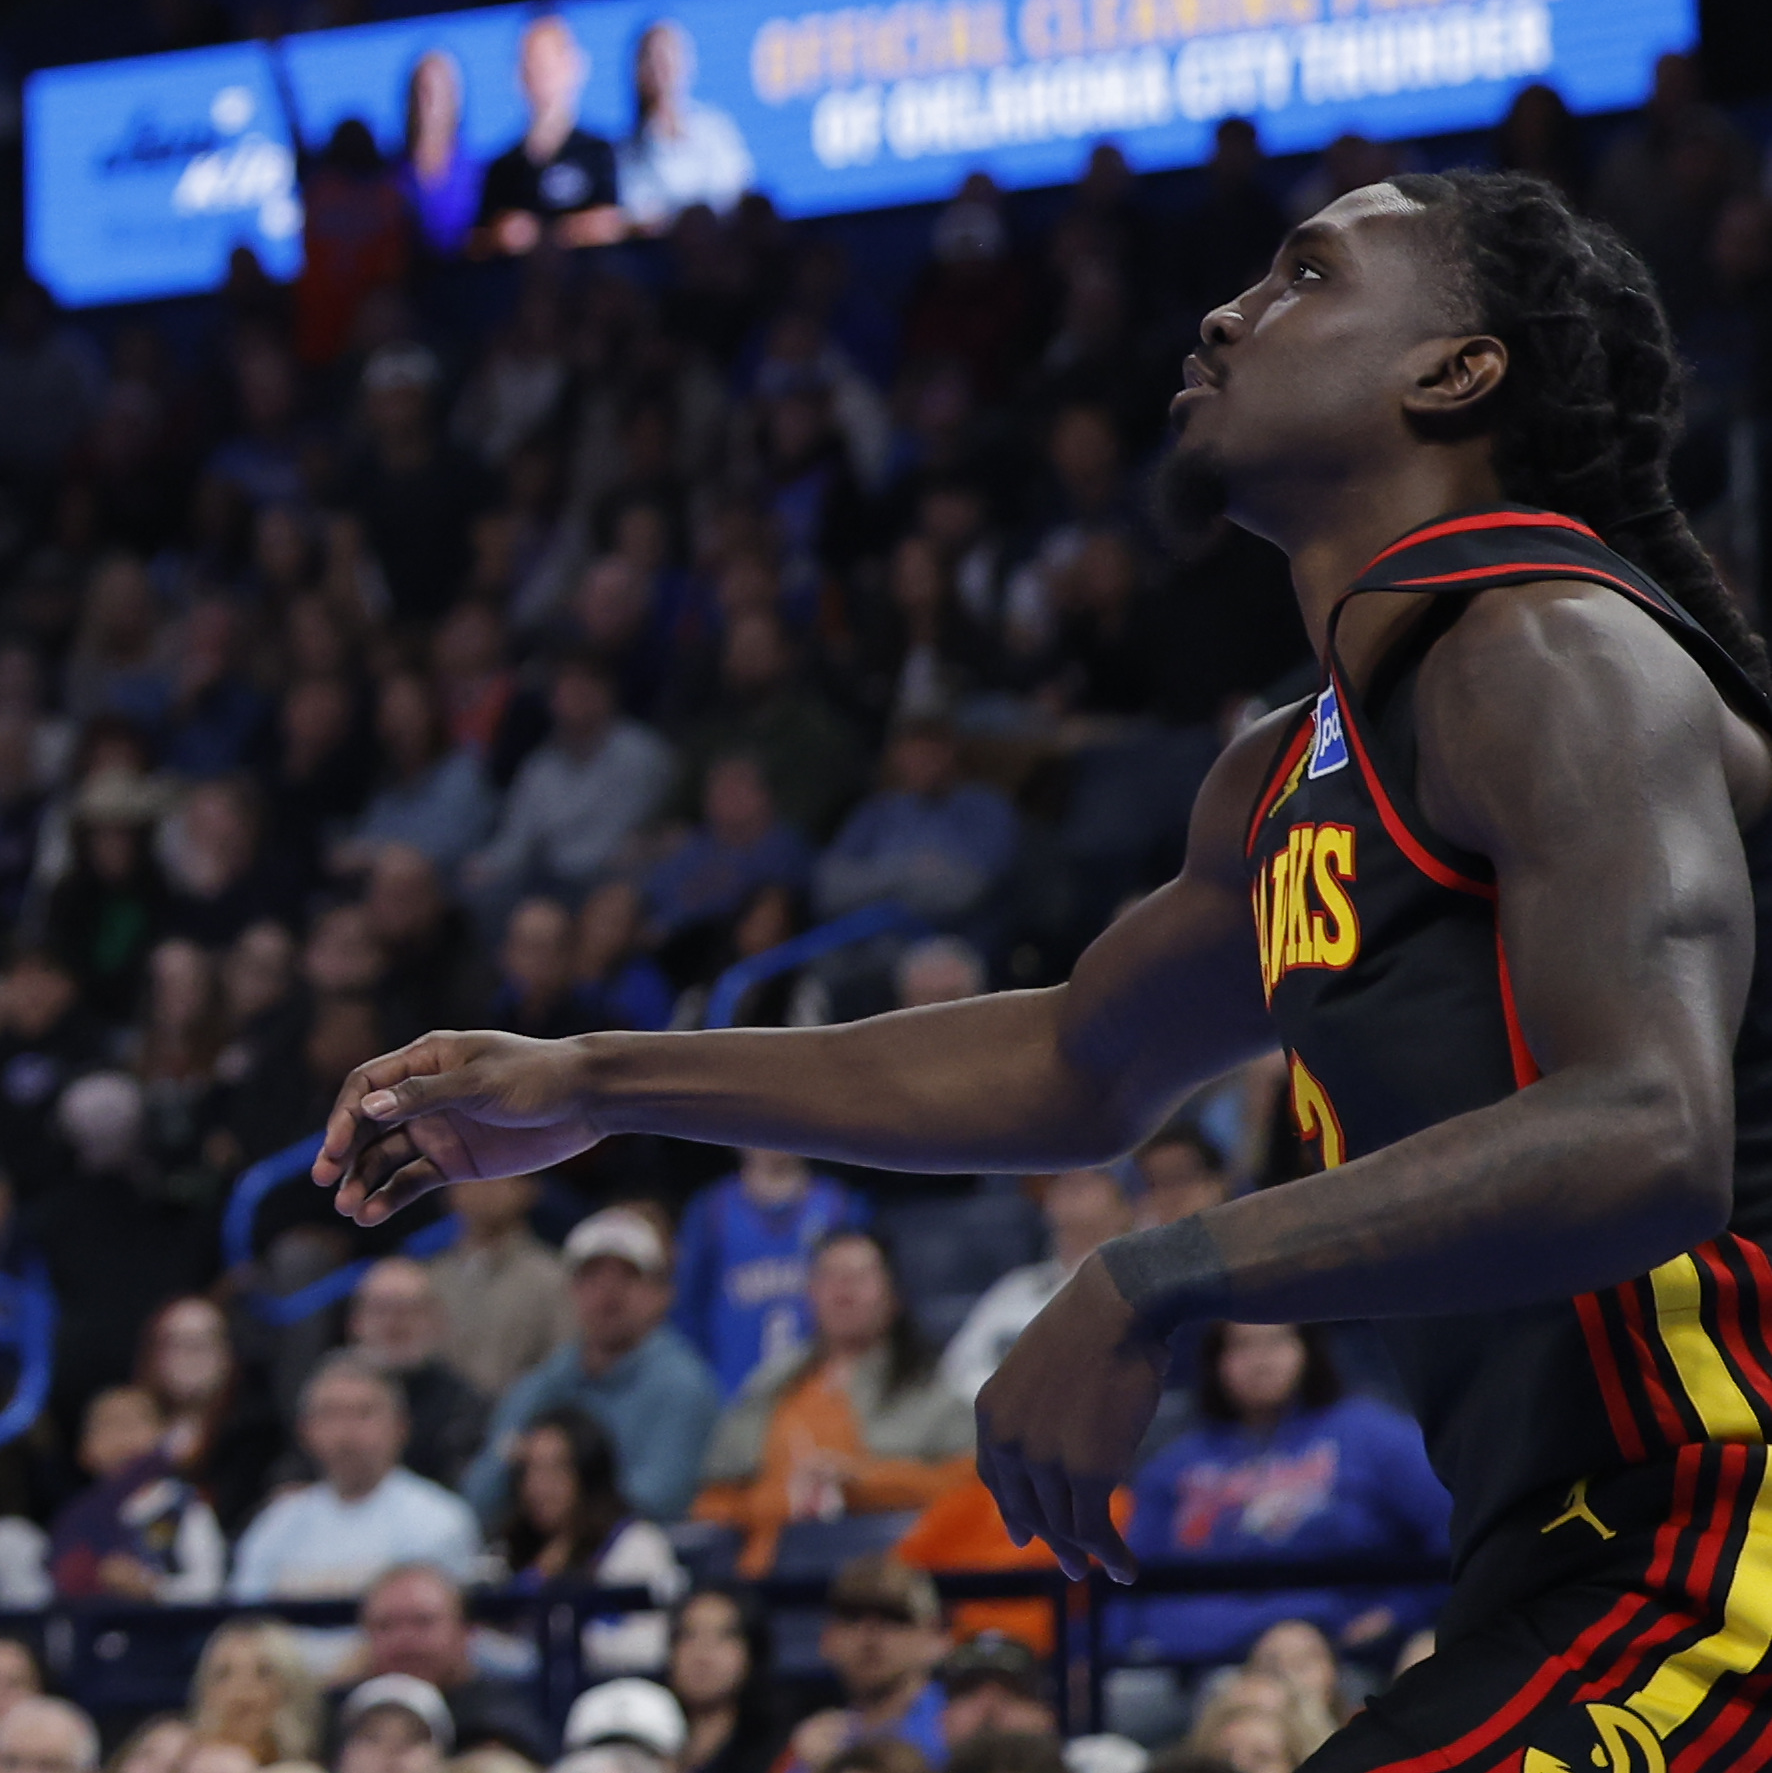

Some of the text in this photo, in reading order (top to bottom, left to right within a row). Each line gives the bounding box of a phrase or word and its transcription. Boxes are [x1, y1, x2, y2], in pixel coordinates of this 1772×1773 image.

[811, 80, 883, 168] OF
[885, 45, 1172, 160] OKLAHOMA
[1174, 30, 1292, 121] CITY
